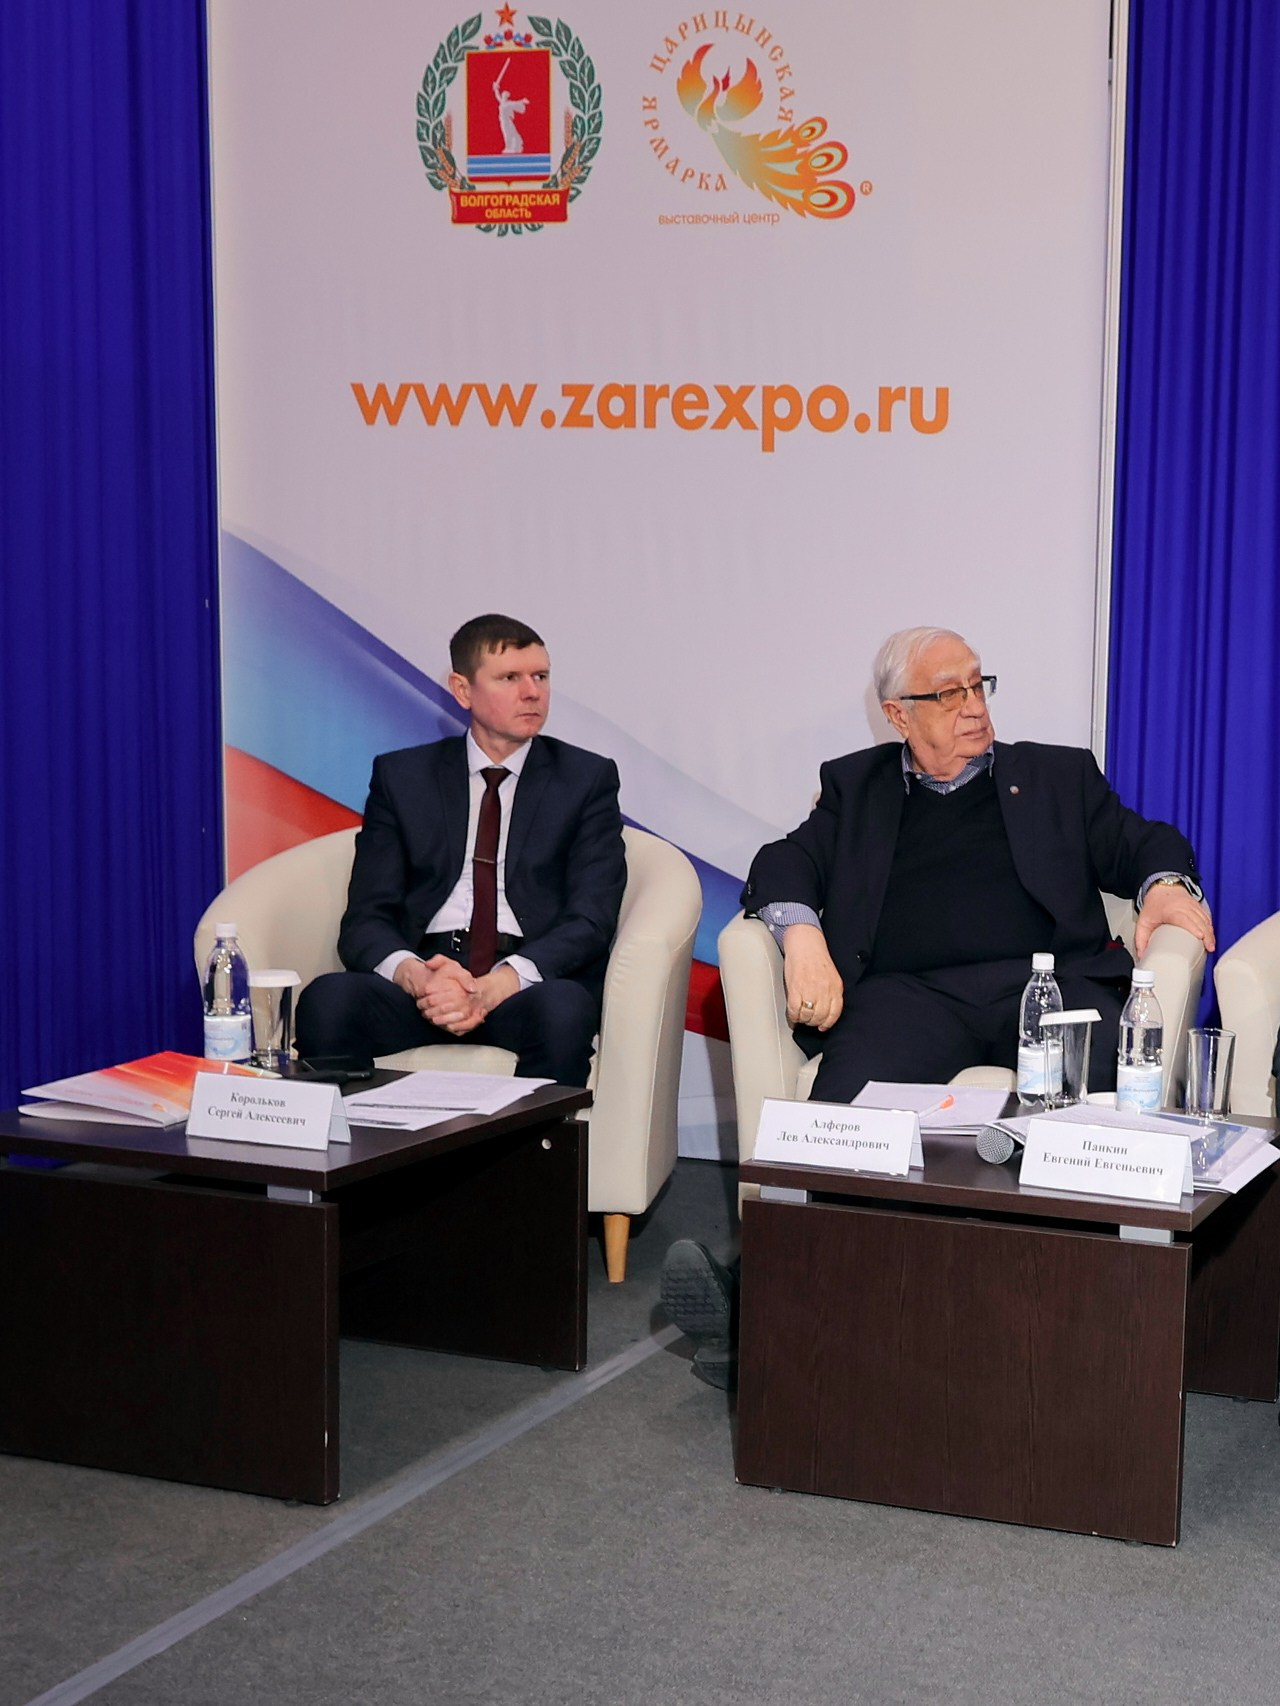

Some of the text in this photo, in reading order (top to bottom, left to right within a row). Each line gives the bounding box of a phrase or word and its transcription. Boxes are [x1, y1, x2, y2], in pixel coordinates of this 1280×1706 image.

[642, 95, 728, 192] ЯРМАРКА
[460, 193, 560, 208] ВОЛГОГРАДСКАЯ
[485, 207, 532, 220] ОБЛАСТЬ
[658, 212, 781, 226] выставочный центр
[350, 382, 951, 453] www.zarexpo.ru
[230, 1092, 286, 1108] Корольков
[207, 1105, 306, 1126] Сергей Алексеевич
[811, 1118, 861, 1133] Алферов
[777, 1130, 890, 1151] Лев Александрович
[1082, 1140, 1128, 1156] Панкин
[1043, 1151, 1164, 1176] Евгений Евгеньевич
